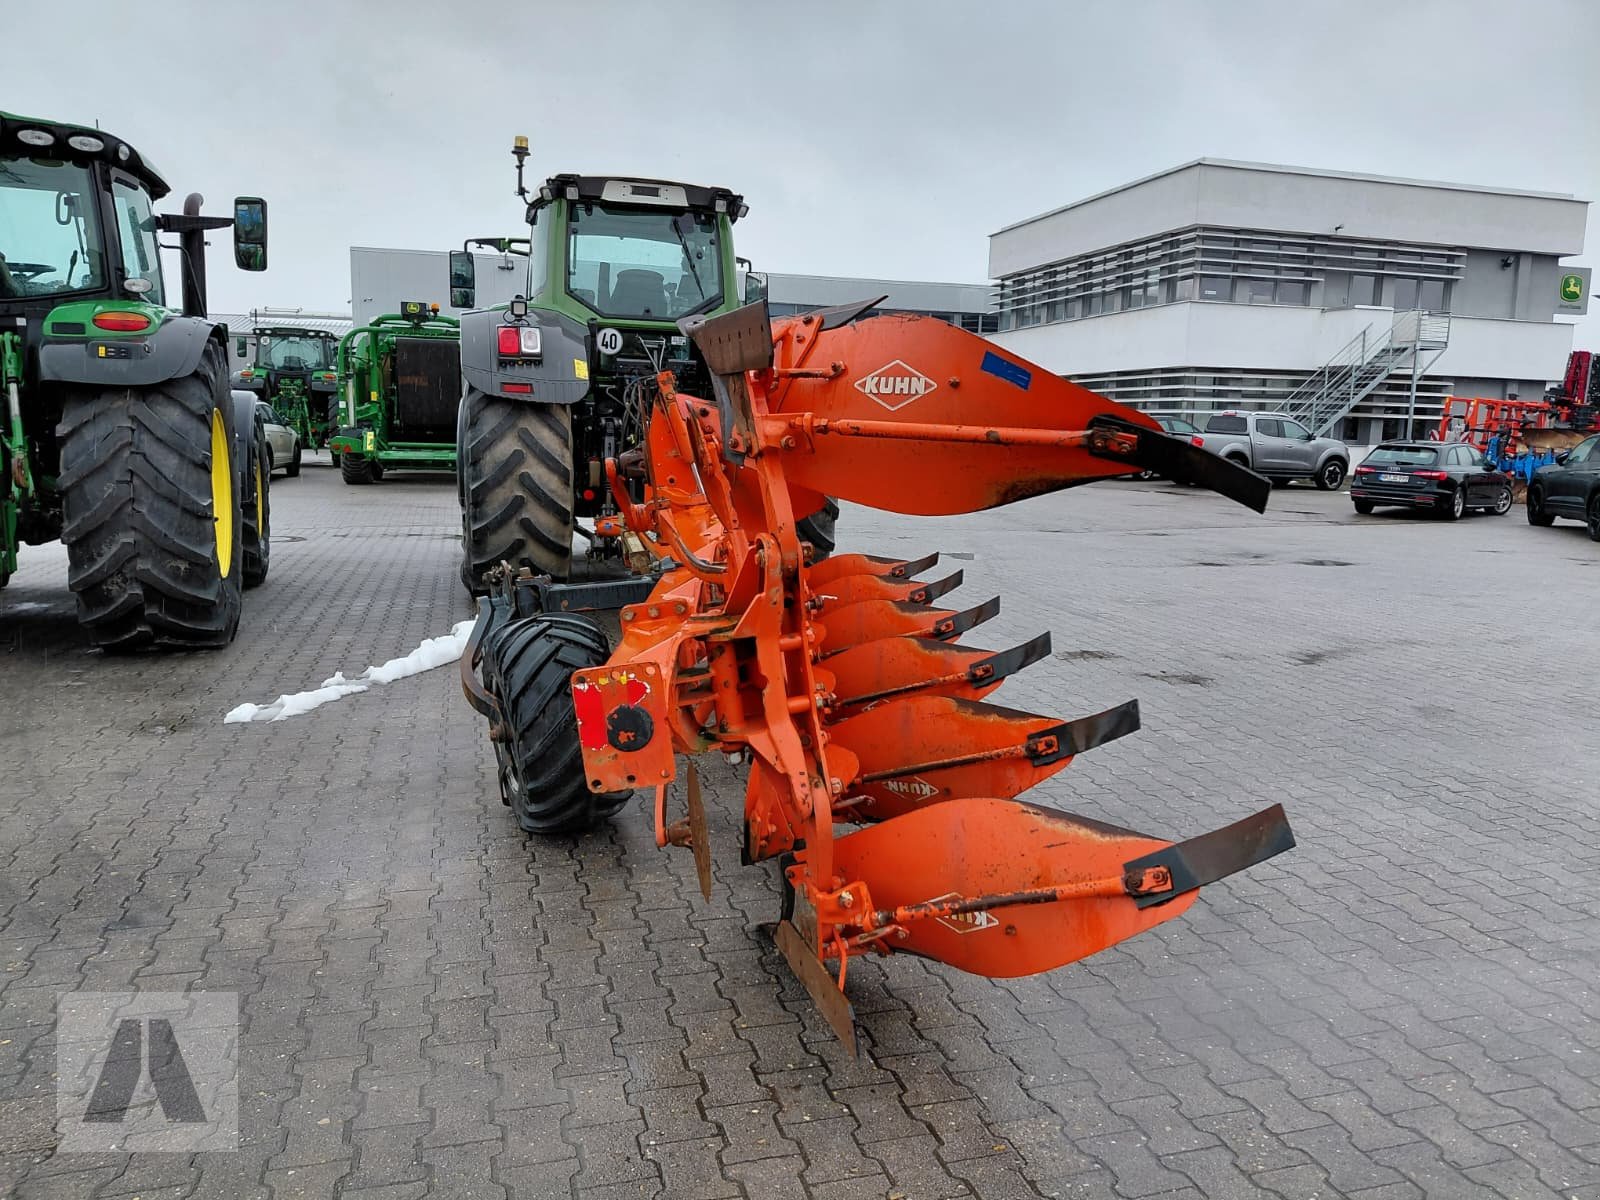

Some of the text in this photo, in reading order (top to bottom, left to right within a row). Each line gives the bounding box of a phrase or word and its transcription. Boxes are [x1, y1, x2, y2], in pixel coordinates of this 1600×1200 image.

[601, 333, 617, 350] 40
[864, 376, 926, 395] KUHN
[887, 780, 931, 798] KUHN
